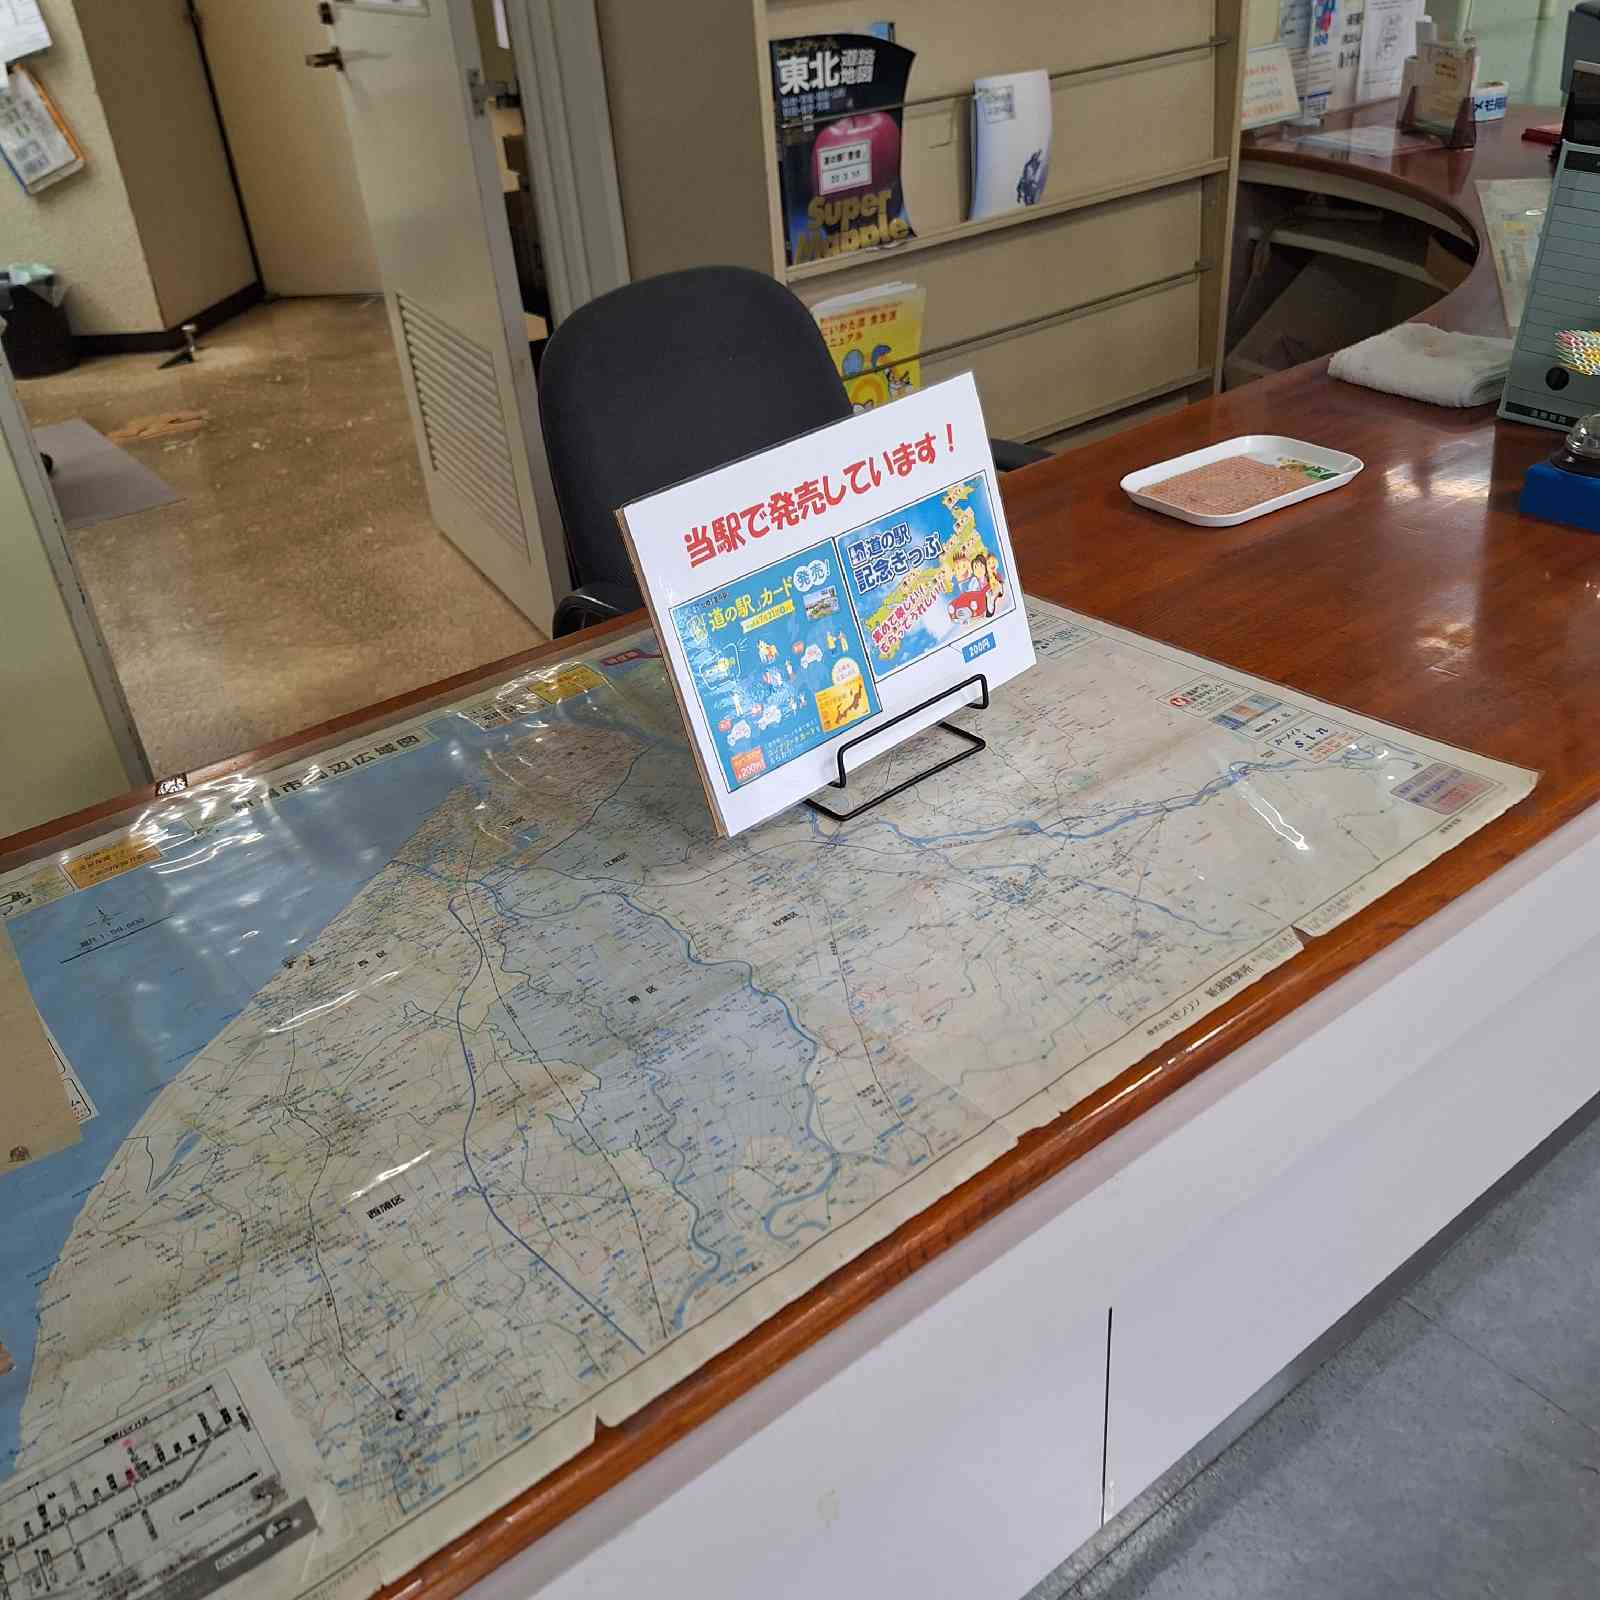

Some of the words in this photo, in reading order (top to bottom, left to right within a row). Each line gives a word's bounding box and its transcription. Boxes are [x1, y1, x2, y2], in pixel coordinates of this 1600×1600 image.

[777, 51, 840, 95] 東北
[808, 190, 892, 233] Super
[684, 423, 956, 569] 当駅で発売しています！
[855, 532, 942, 594] 記念きっぷ
